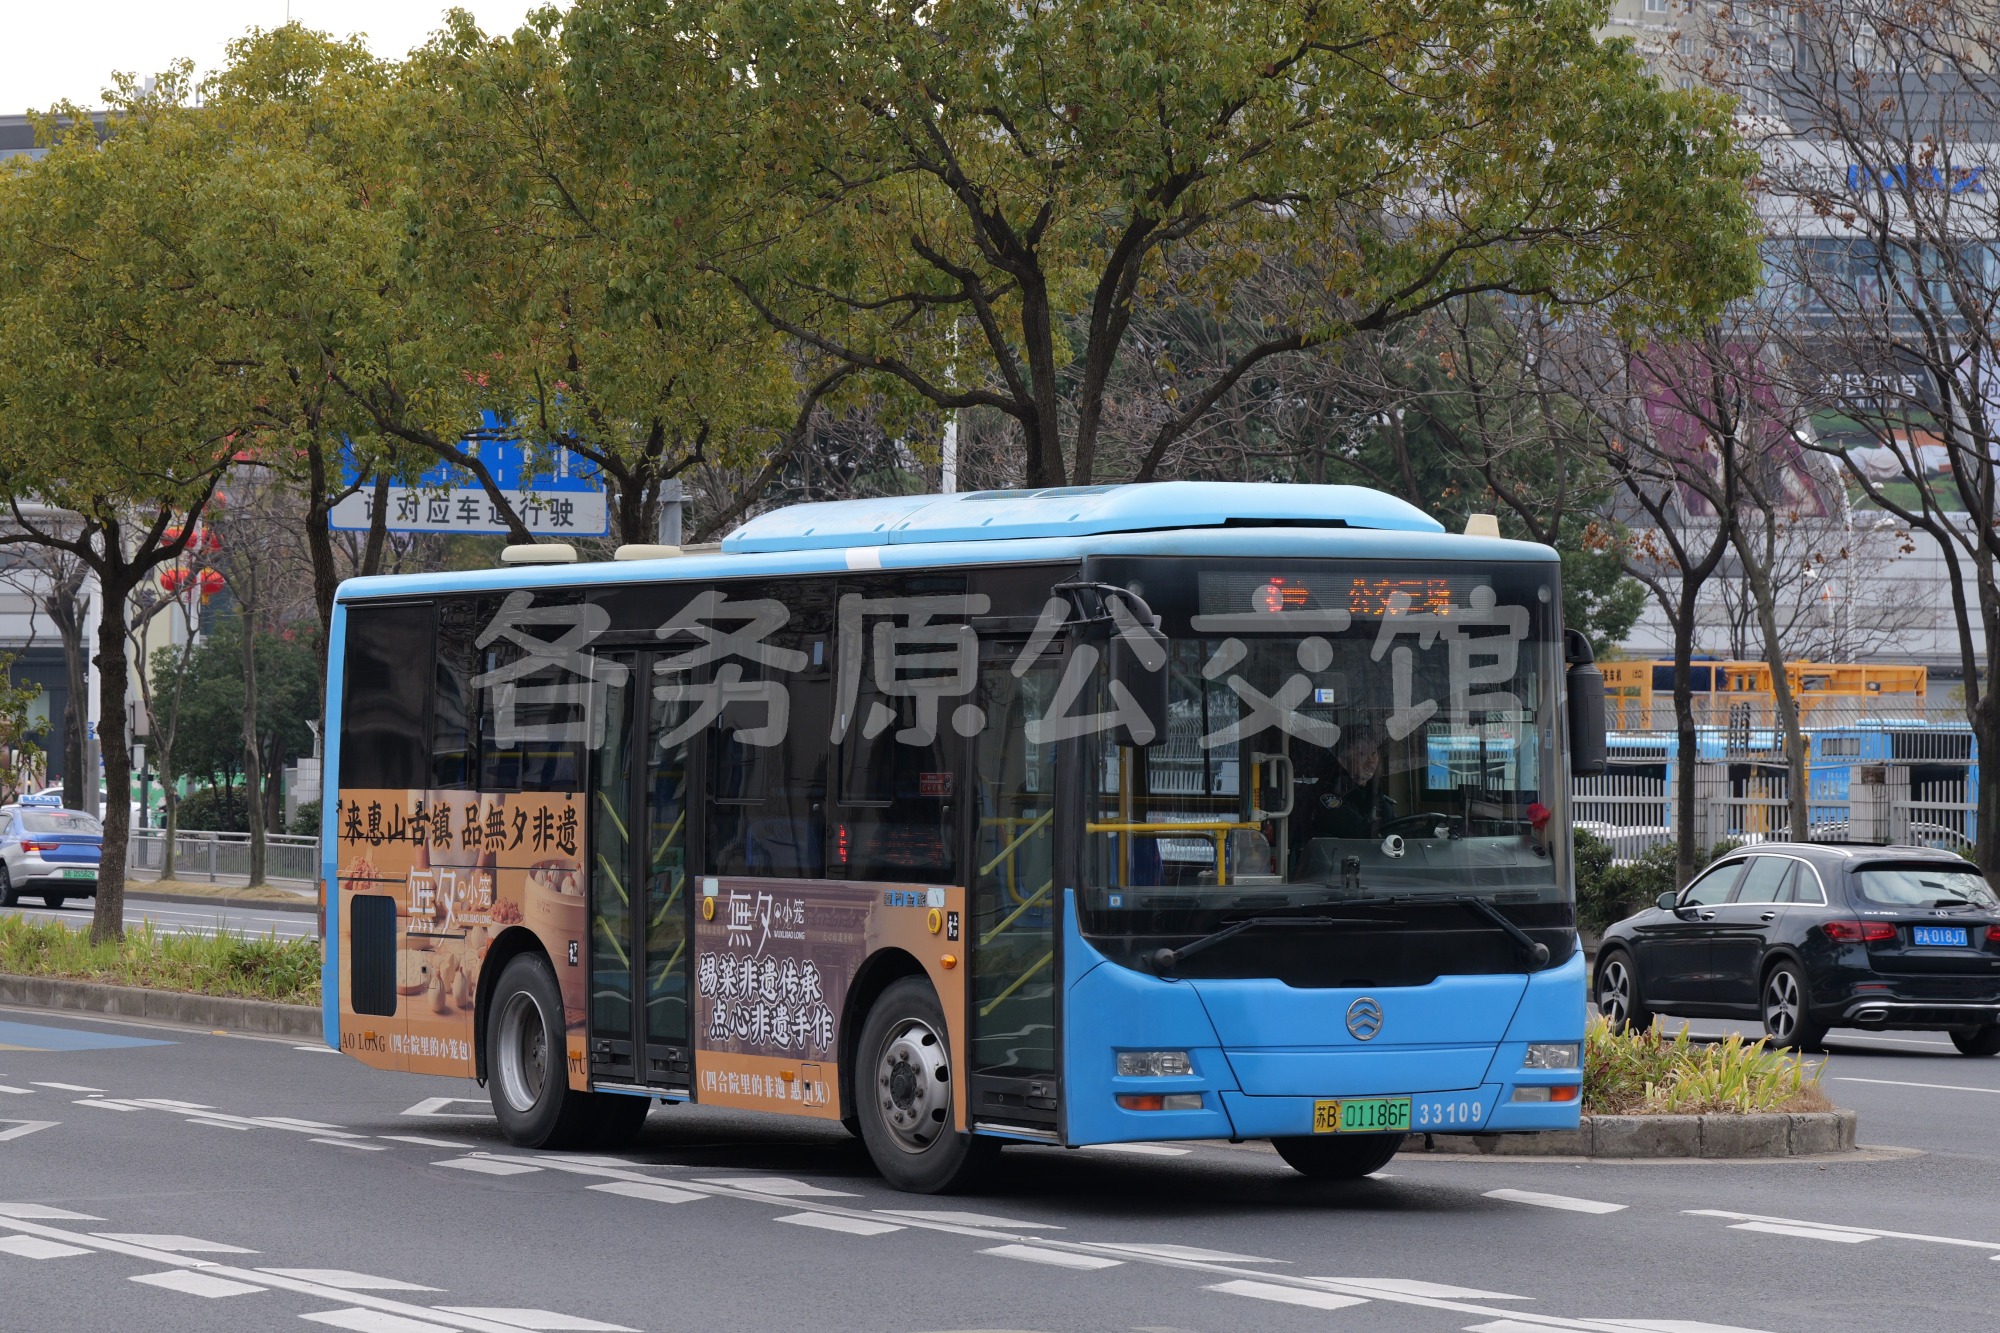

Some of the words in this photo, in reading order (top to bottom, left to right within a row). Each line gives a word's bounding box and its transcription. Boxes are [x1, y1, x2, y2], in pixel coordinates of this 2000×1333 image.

[1600, 669, 1622, 682] 洗车机
[344, 800, 453, 850] 来惠山古镇
[461, 803, 578, 856] 品無夕非遗
[711, 998, 833, 1052] 点心非遗手作
[568, 1055, 586, 1075] WU
[1420, 1102, 1482, 1125] 33109
